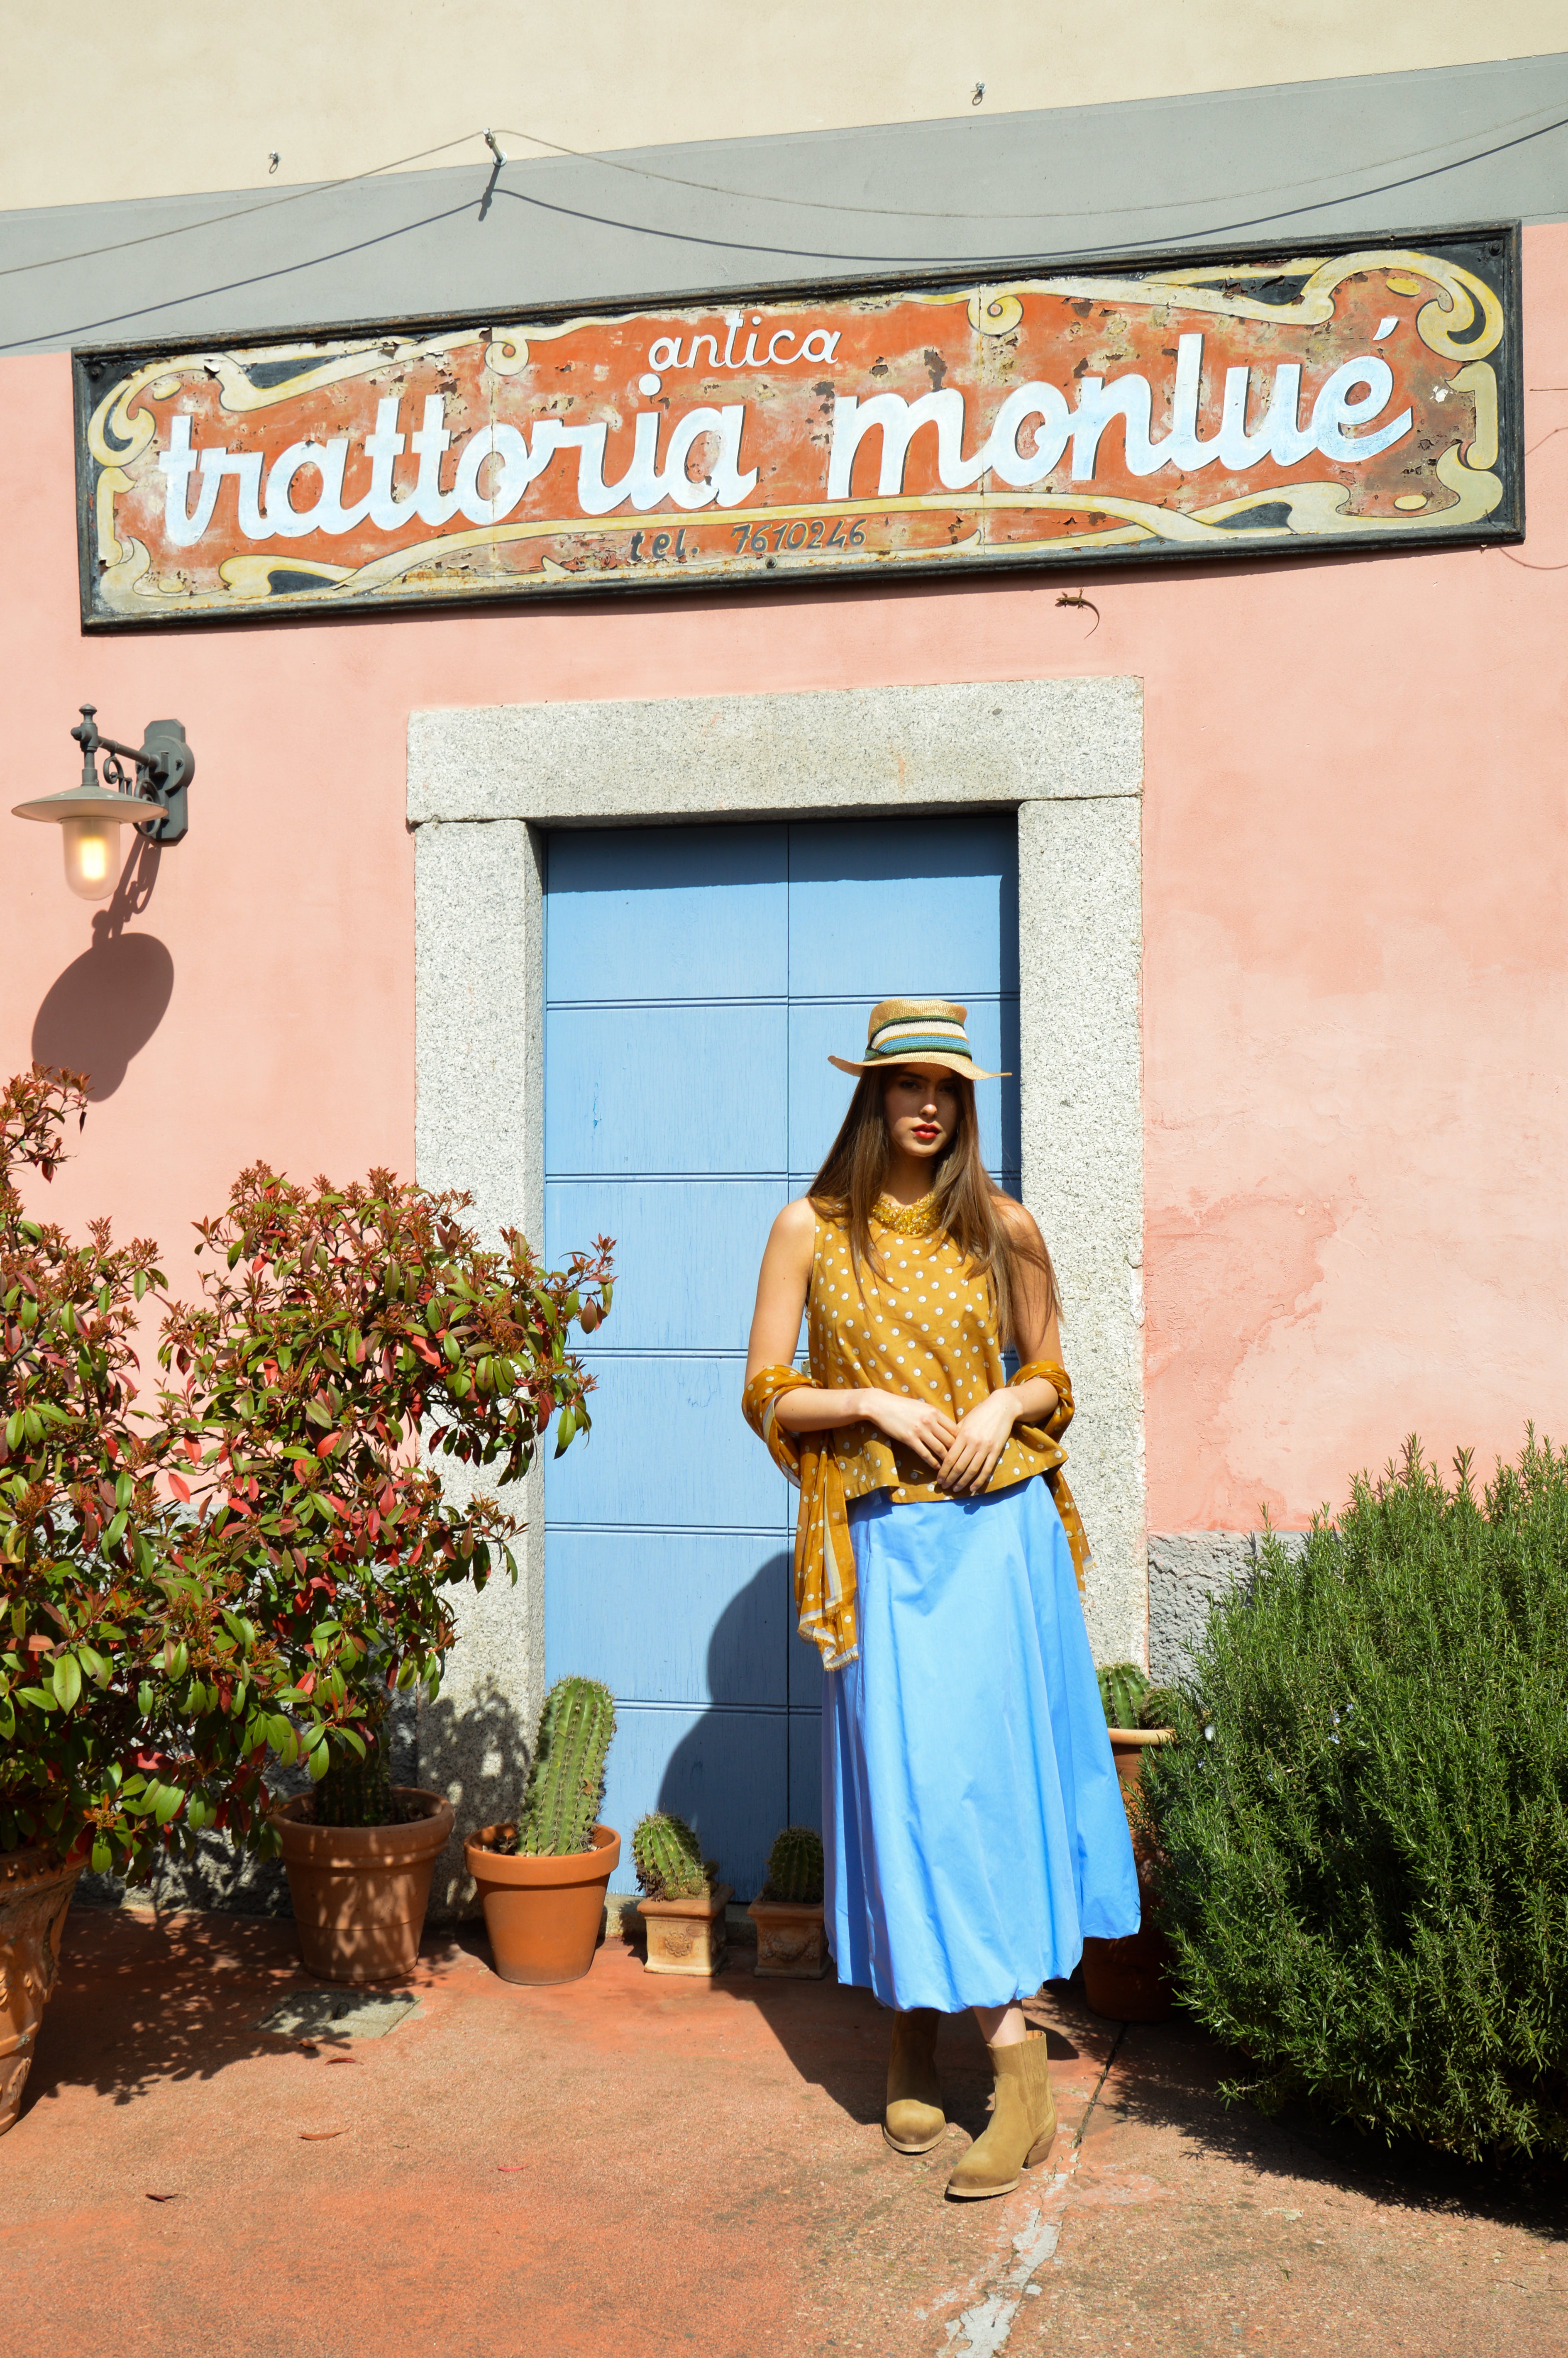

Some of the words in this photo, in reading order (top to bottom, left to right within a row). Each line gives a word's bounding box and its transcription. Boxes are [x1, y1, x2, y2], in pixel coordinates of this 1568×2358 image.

[648, 309, 842, 372] antica
[159, 373, 758, 547] trattoria
[828, 317, 1412, 500] monlué
[630, 529, 700, 563] tel.
[730, 518, 867, 554] 7610246
